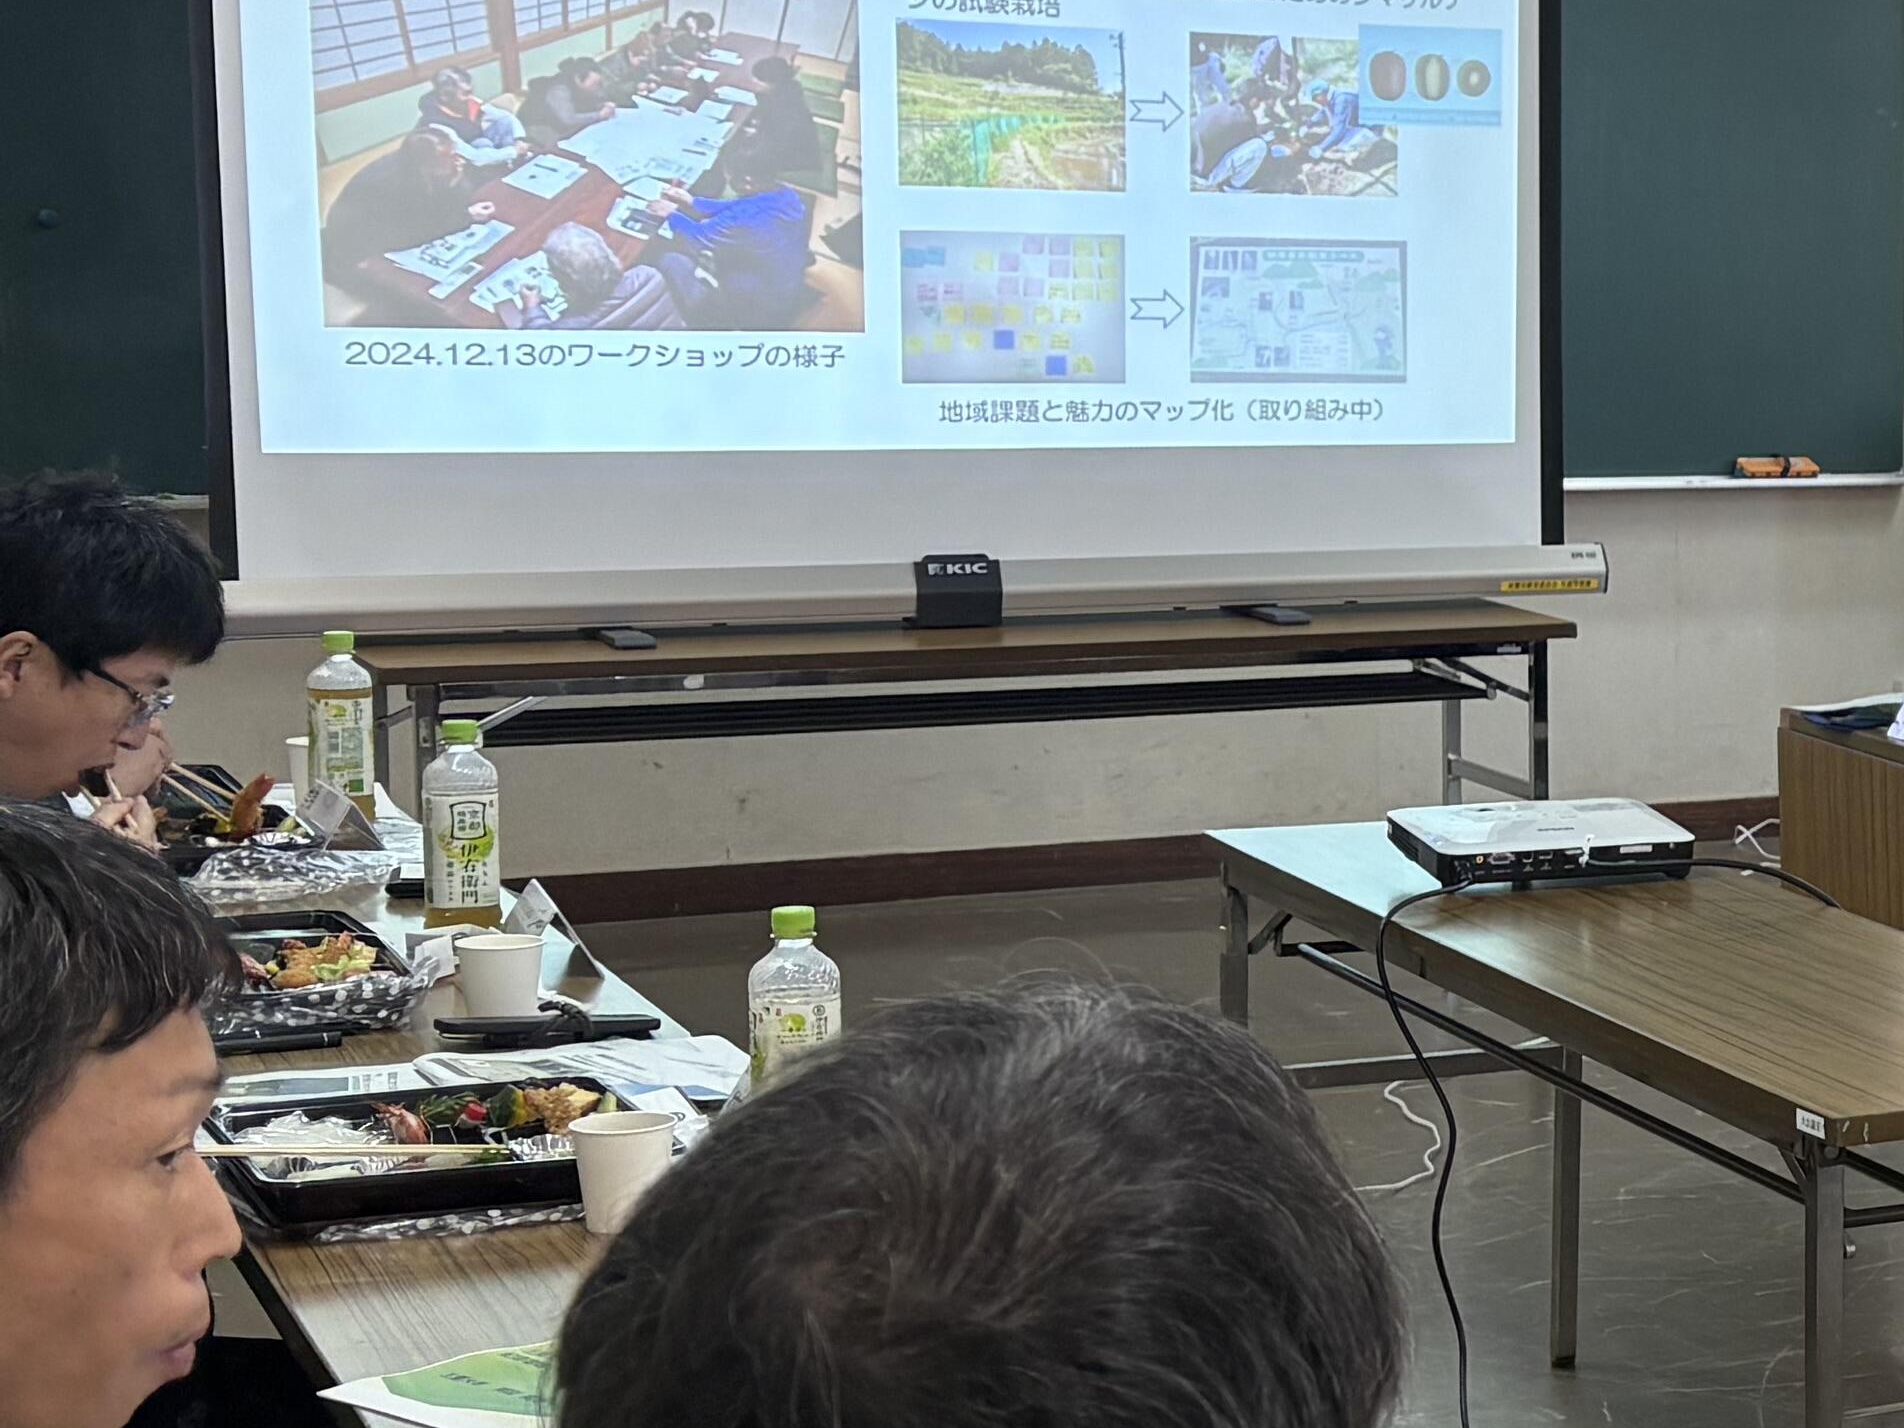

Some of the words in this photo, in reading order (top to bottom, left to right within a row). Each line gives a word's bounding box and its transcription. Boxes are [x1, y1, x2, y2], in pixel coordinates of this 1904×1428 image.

[344, 341, 846, 369] 2024.12.13のワークショップの様子
[938, 398, 1385, 425] 地域課題と魅力のマップ化（取り組み中）
